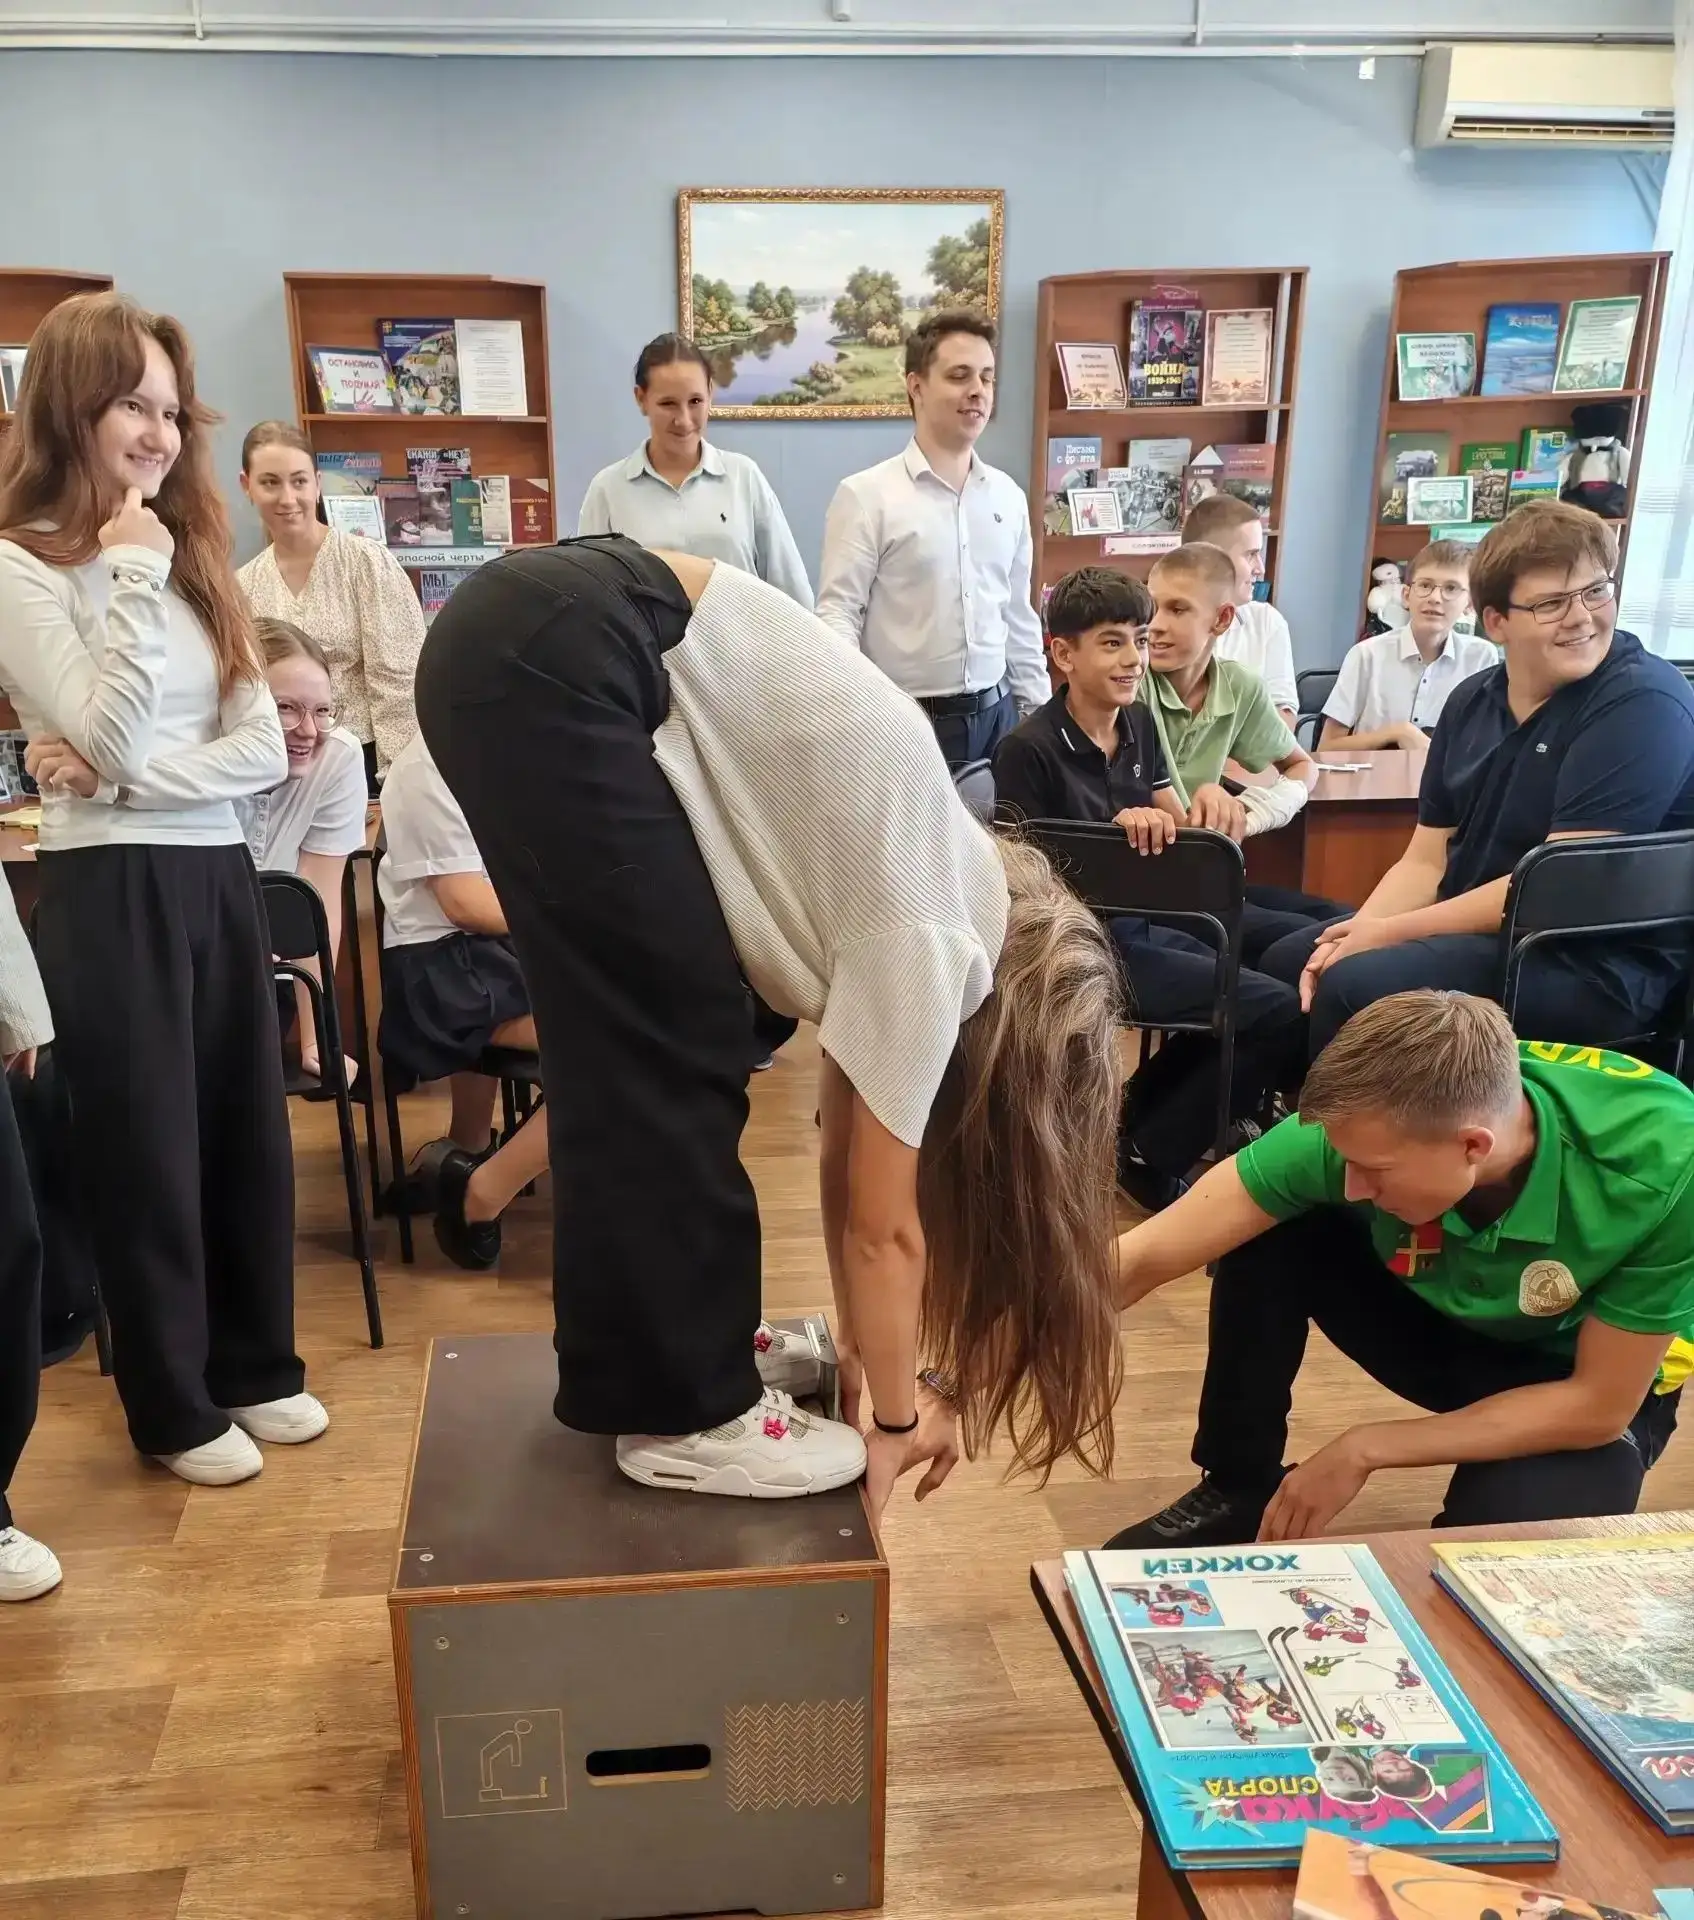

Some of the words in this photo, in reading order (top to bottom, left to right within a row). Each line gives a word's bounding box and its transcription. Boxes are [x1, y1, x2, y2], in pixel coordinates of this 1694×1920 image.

[1143, 361, 1186, 376] ВОЙНА
[397, 553, 446, 562] опасной
[450, 554, 484, 564] черты
[422, 573, 446, 587] МЫ
[1143, 1554, 1302, 1578] ХОККЕЙ
[1205, 1776, 1320, 1797] СПОРТА
